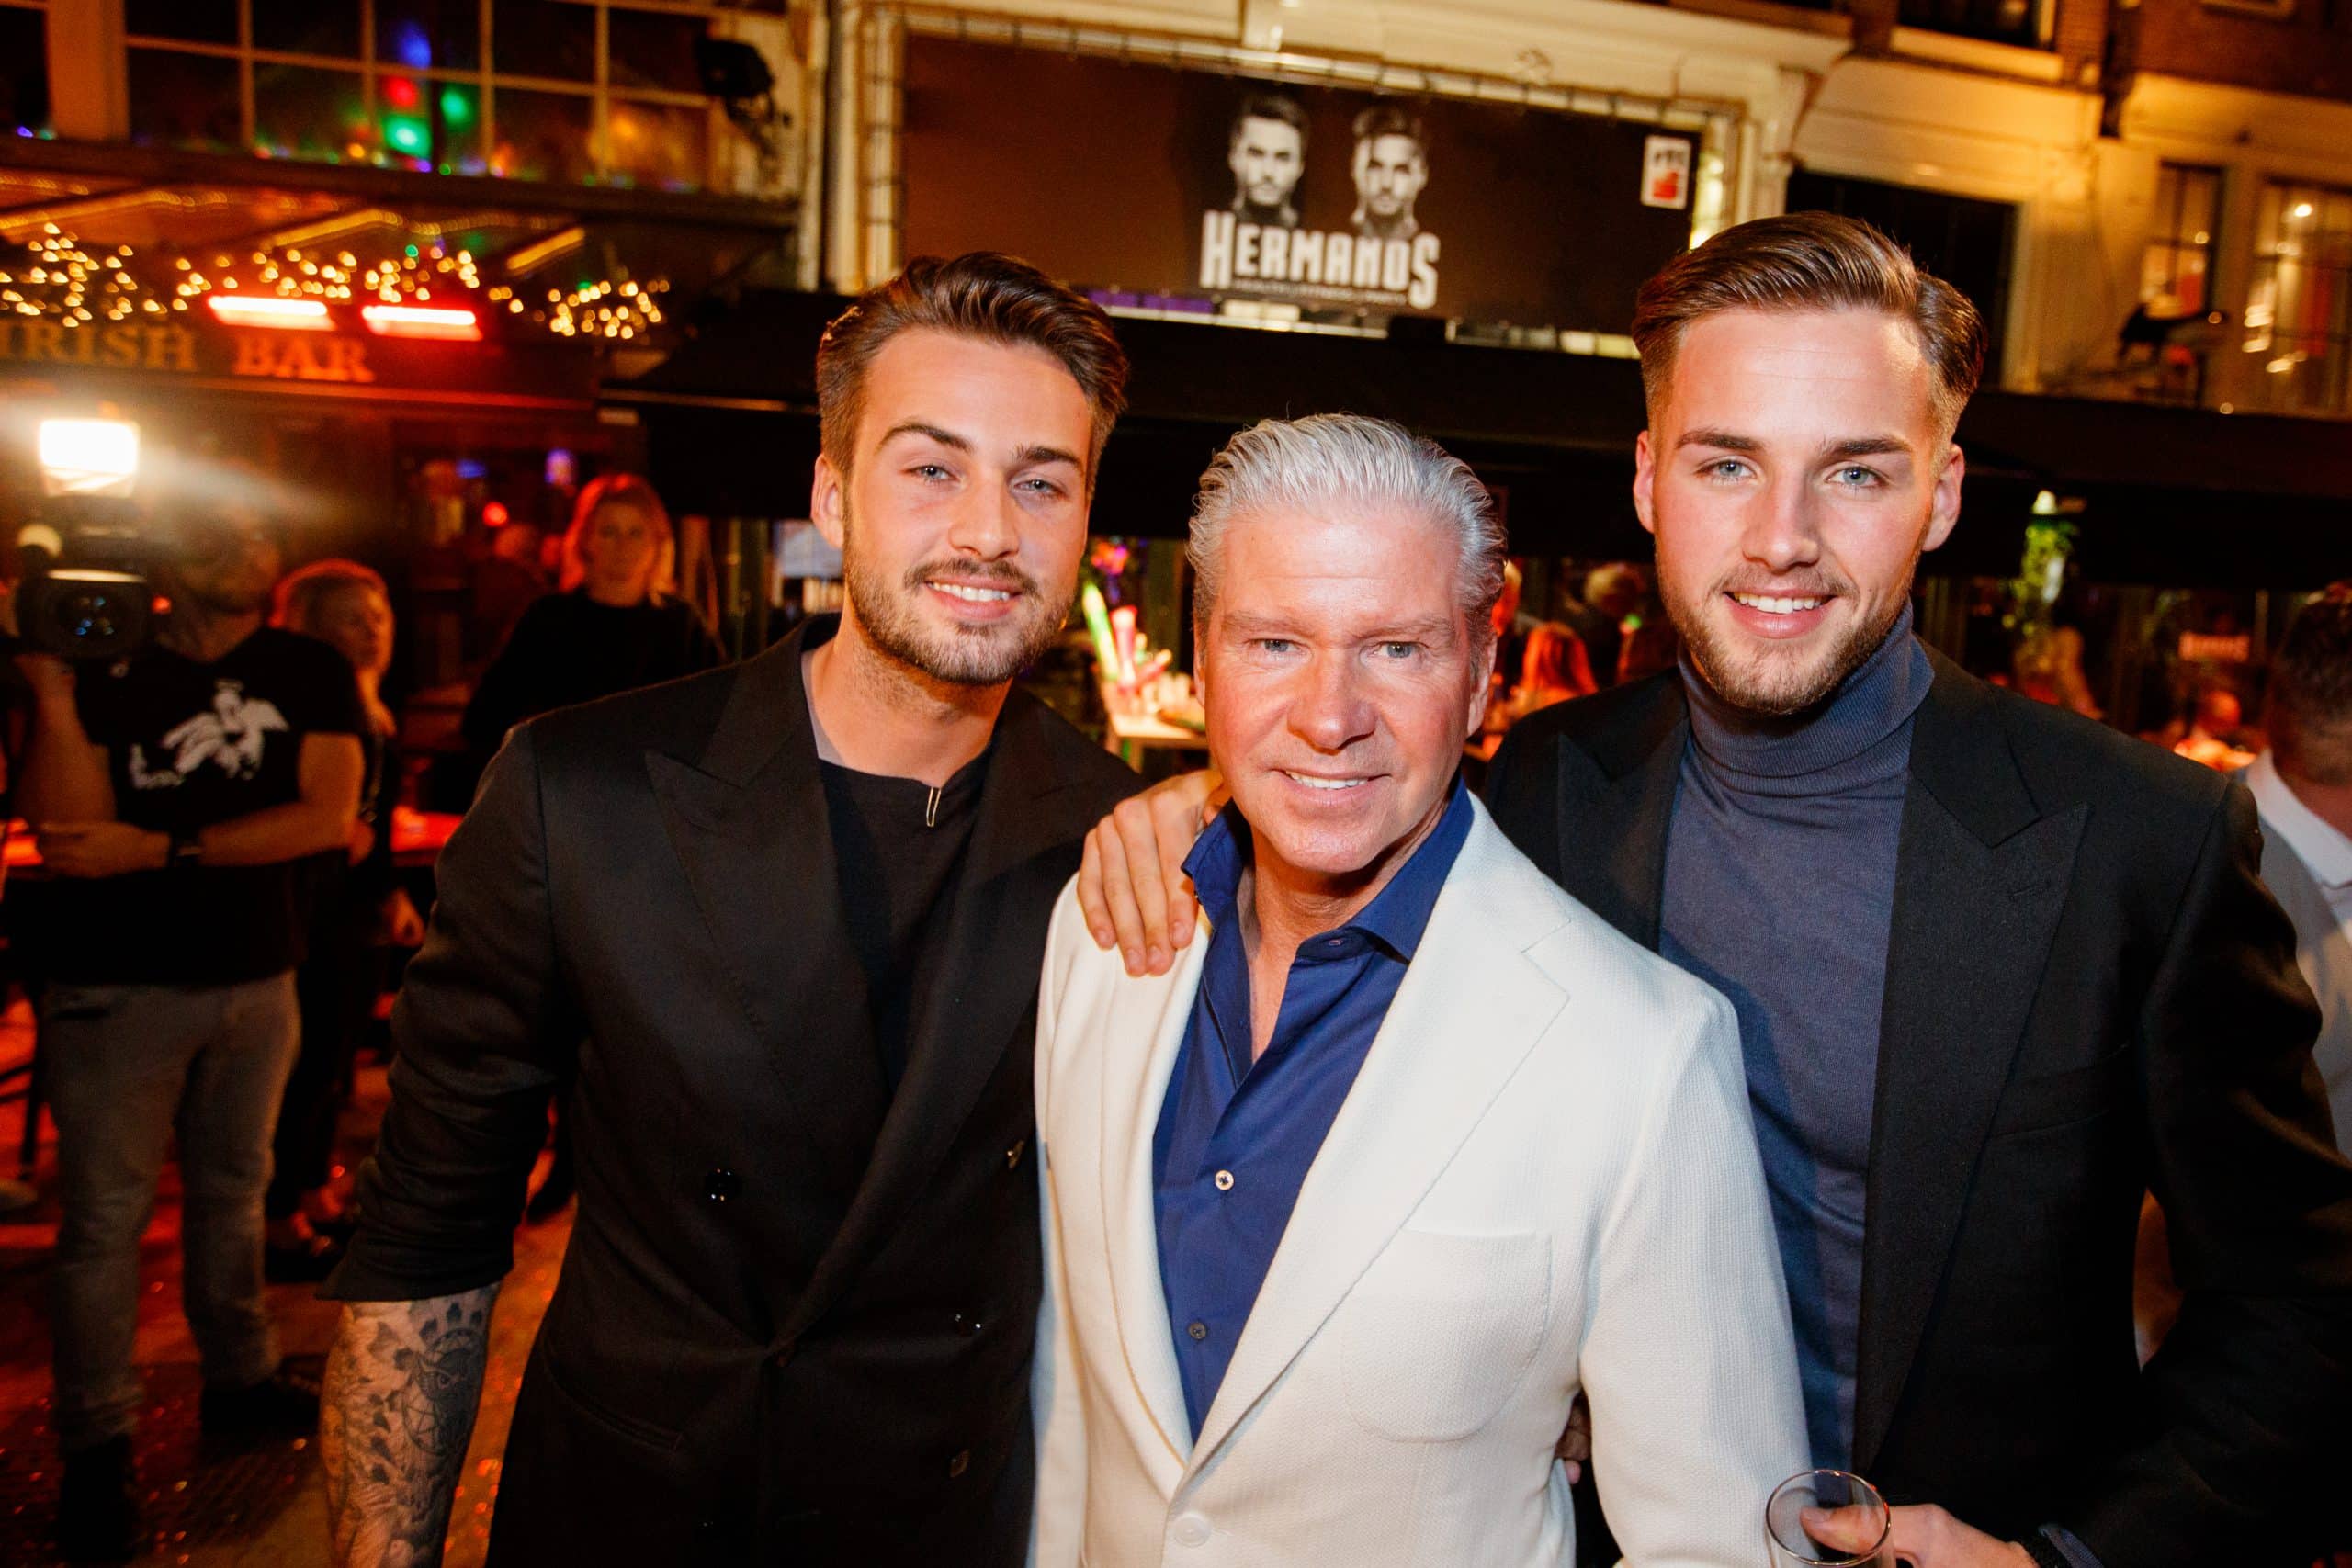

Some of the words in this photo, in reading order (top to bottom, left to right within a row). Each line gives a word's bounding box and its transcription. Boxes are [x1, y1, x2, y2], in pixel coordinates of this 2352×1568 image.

[1199, 209, 1441, 310] HERMANOS
[0, 318, 197, 372] IRISH
[232, 333, 375, 382] BAR
